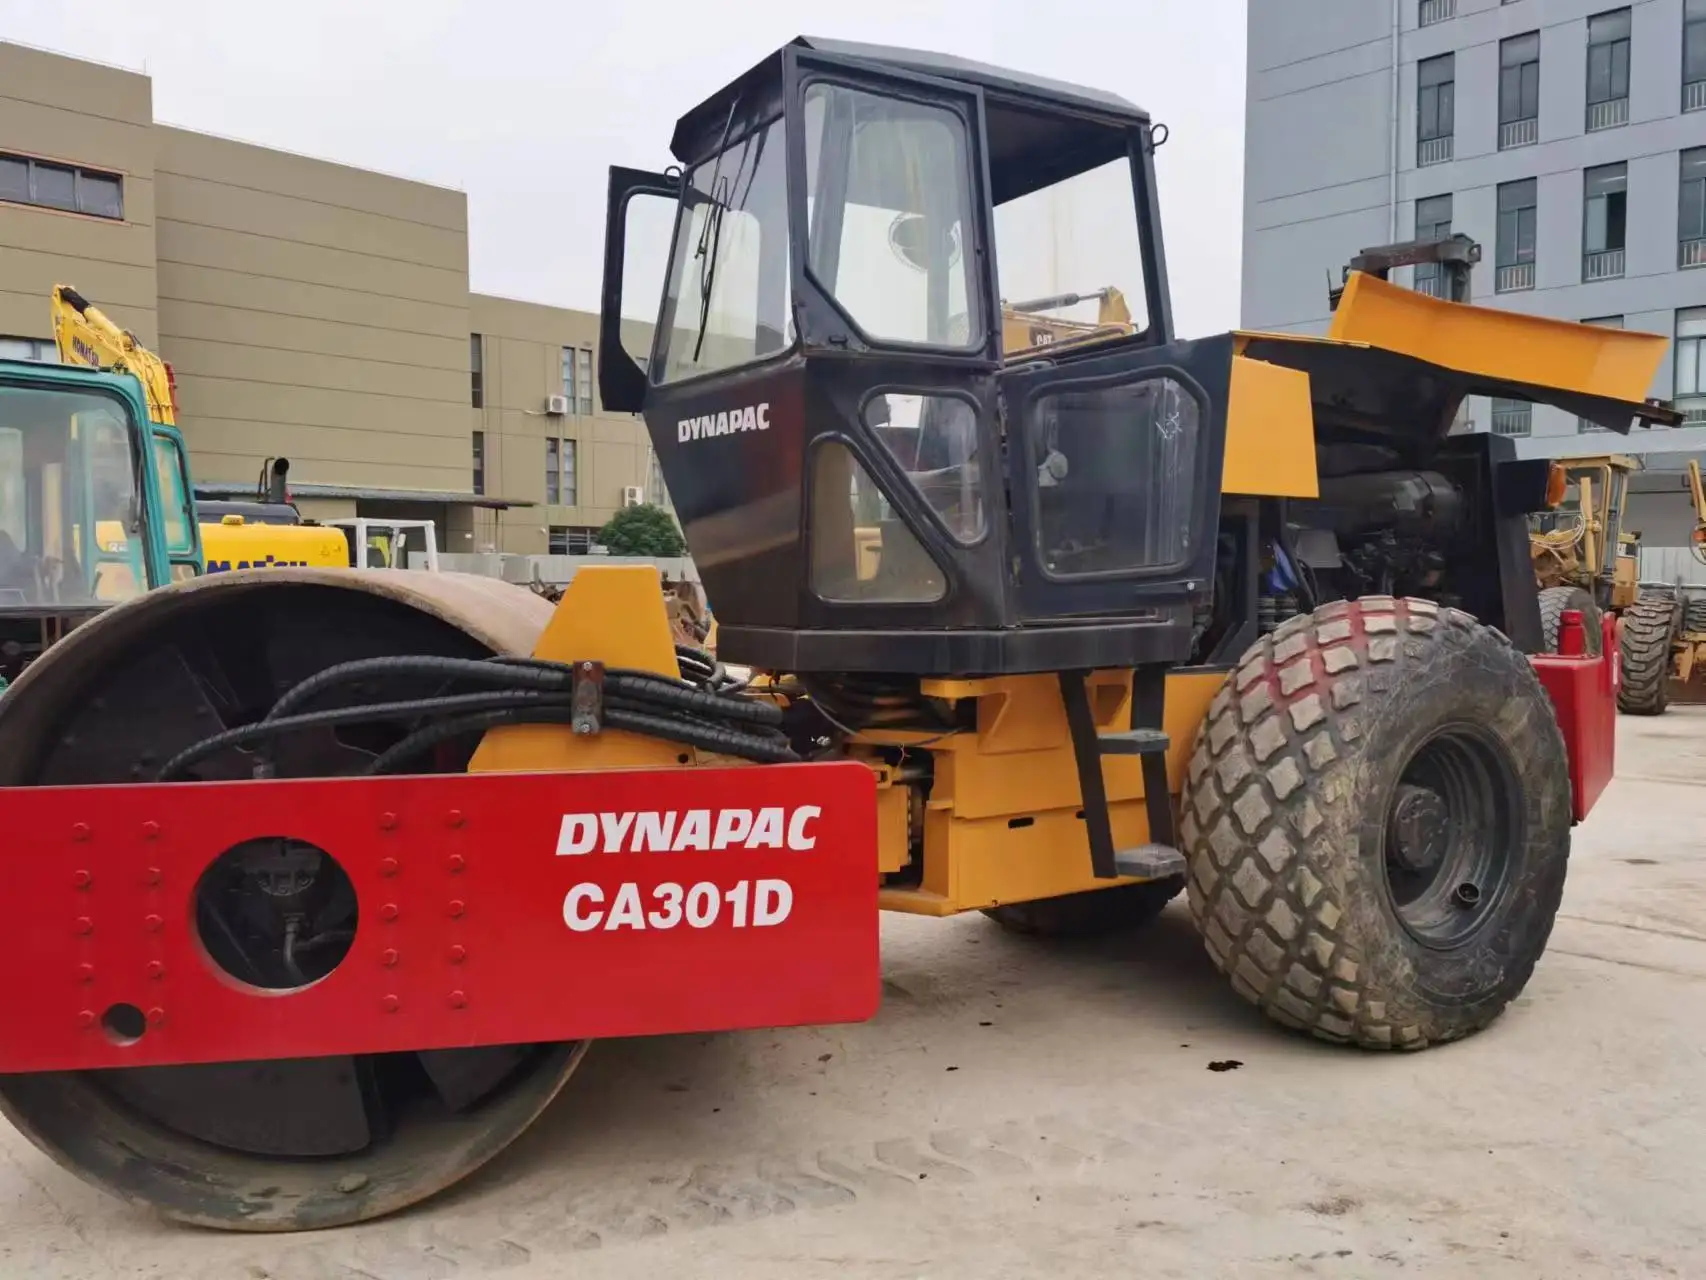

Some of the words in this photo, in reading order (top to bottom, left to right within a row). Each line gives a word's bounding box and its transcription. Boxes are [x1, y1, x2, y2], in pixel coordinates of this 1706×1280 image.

[1036, 334, 1053, 346] CAT
[678, 403, 770, 443] DYNAPAC
[555, 805, 821, 856] DYNAPAC
[563, 879, 793, 932] CA301D
